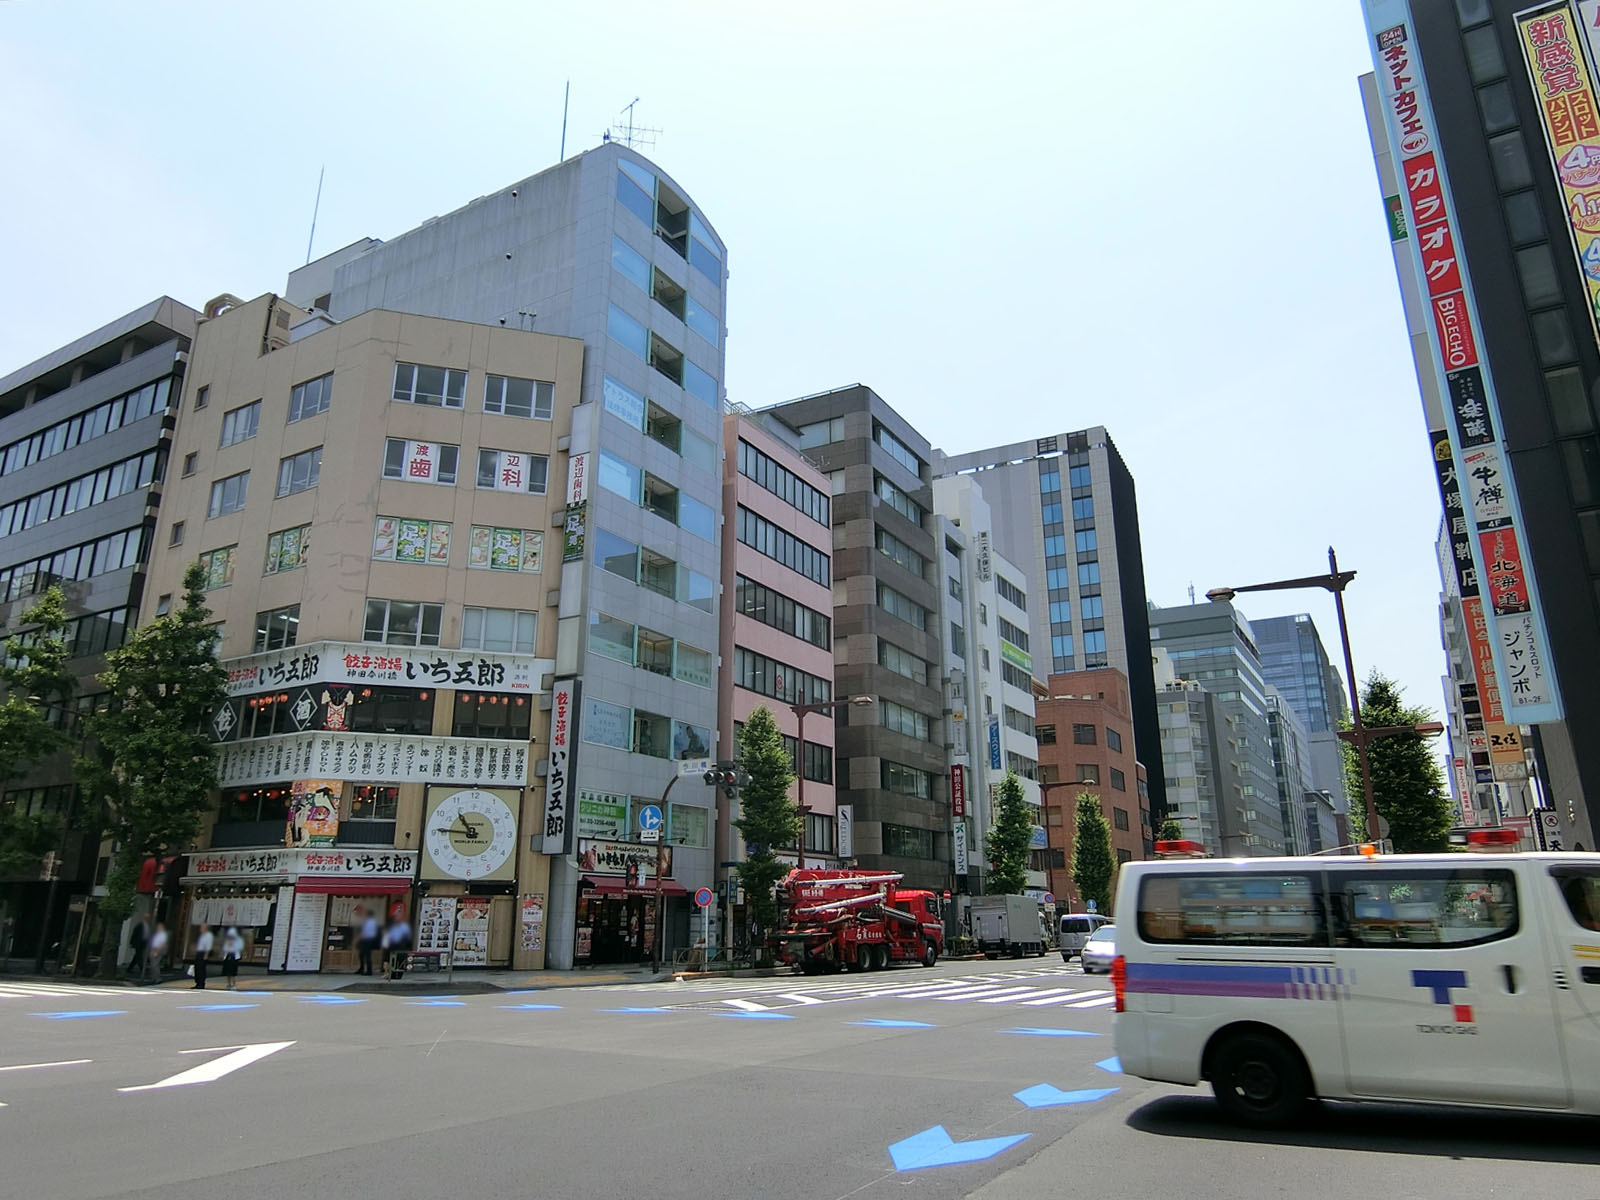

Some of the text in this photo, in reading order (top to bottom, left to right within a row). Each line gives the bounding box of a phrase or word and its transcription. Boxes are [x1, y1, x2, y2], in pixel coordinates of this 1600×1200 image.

[1528, 13, 1583, 98] 新感覚
[1385, 45, 1423, 135] ネットカフェ
[1549, 96, 1573, 143] パチンコ
[1571, 92, 1595, 137] スロット
[1410, 167, 1455, 281] カラオケ
[1437, 297, 1458, 325] BIG
[1448, 325, 1466, 366] ECHO
[1458, 399, 1488, 437] 楽蔵
[409, 458, 521, 487] 歯 科
[507, 455, 519, 467] 辺
[1490, 560, 1525, 607] 北海道
[259, 653, 319, 685] いち五郎
[344, 654, 402, 670] 餃子酒場
[406, 657, 504, 687] いち五郎
[1504, 631, 1530, 694] ジャンボ
[555, 692, 568, 745] 餃子酒場
[348, 742, 359, 774] ハムカツ
[546, 751, 566, 837] いち五郎
[241, 853, 277, 872] いち五郎
[306, 855, 343, 865] 餃子酒場
[346, 855, 411, 873] いち五郎
[957, 836, 966, 871] サイエンス
